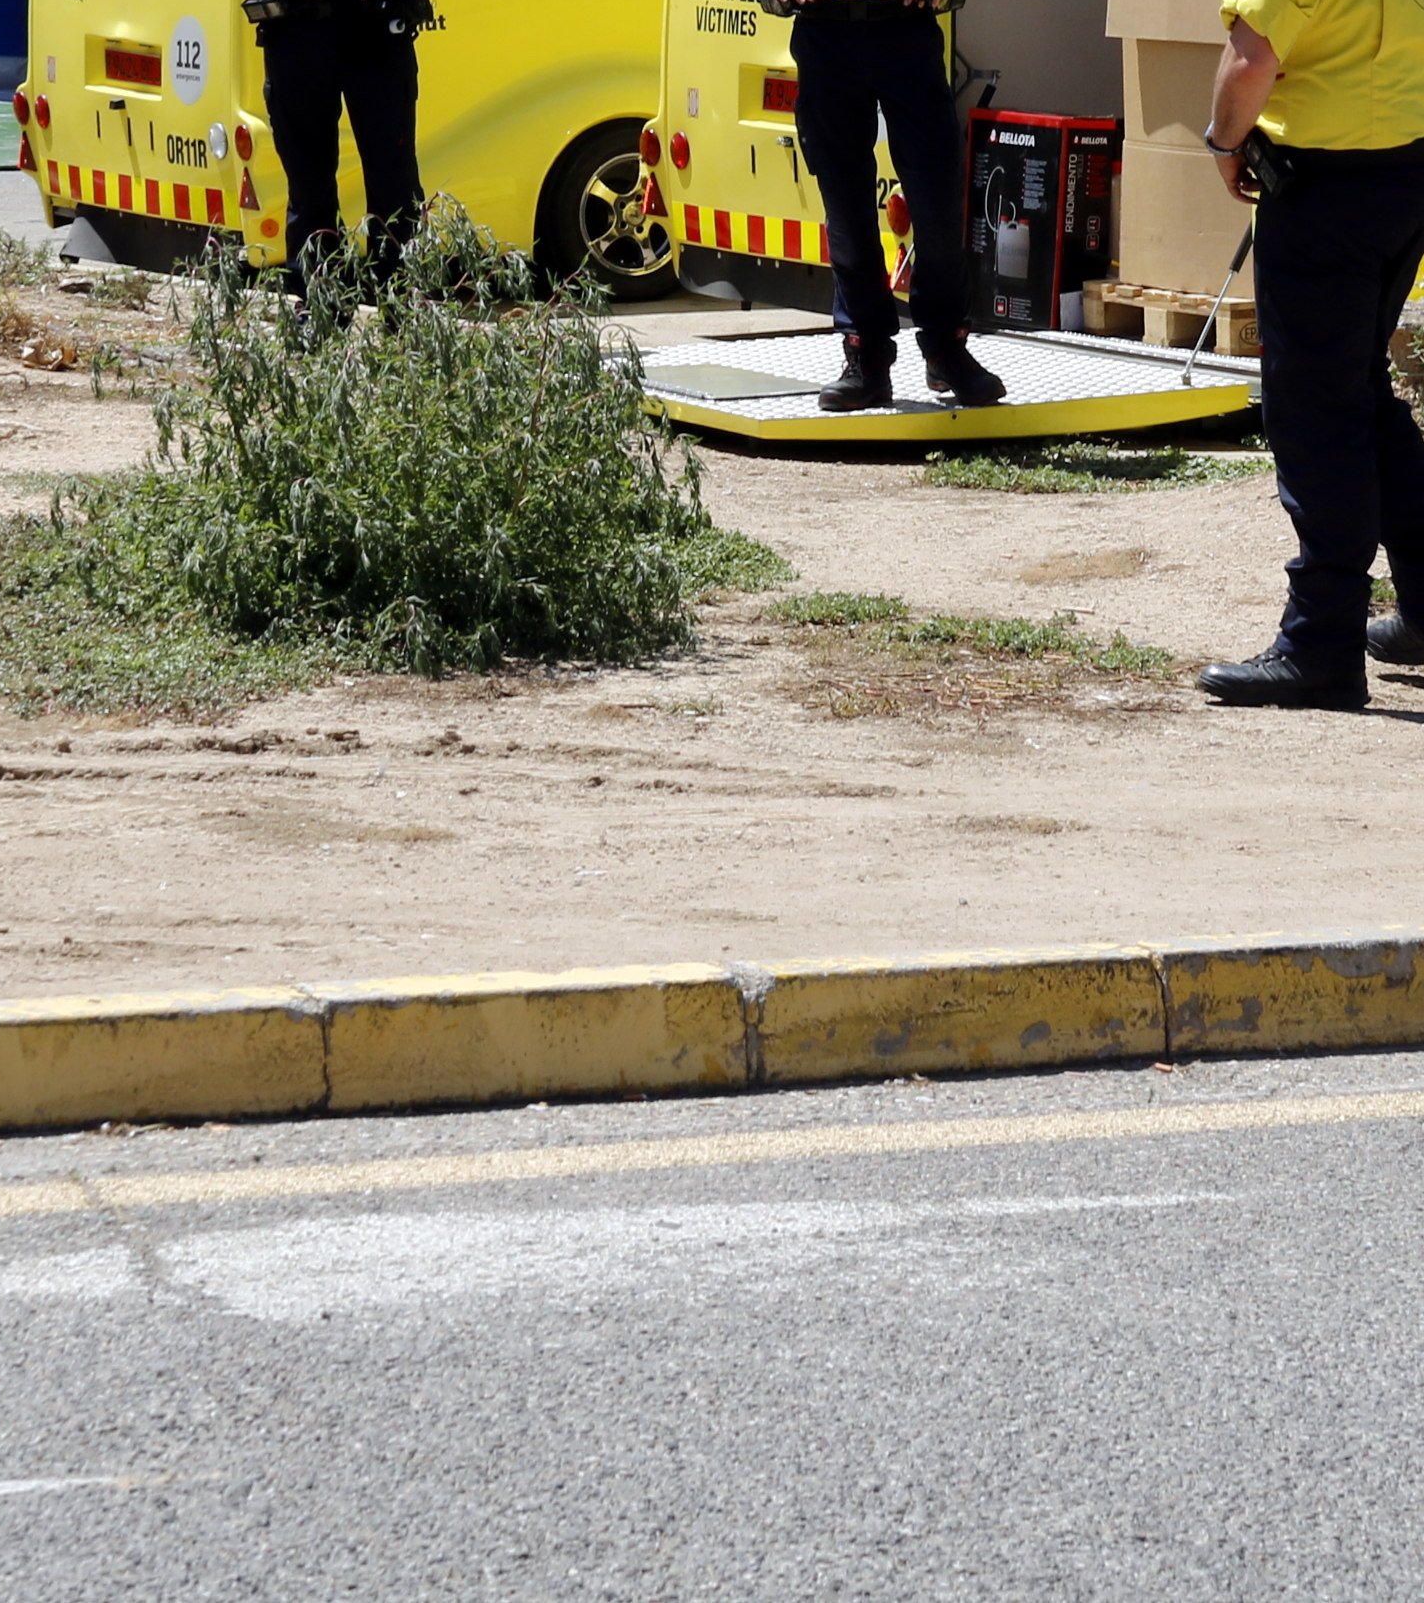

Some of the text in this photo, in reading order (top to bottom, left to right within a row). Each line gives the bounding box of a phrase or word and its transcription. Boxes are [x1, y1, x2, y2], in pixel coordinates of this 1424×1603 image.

[695, 0, 758, 37] VÍCTIMES
[176, 39, 201, 70] 112
[999, 131, 1036, 147] BELLOTA
[1081, 136, 1108, 145] BELLOTA
[1064, 153, 1078, 234] RENDIMIENTO
